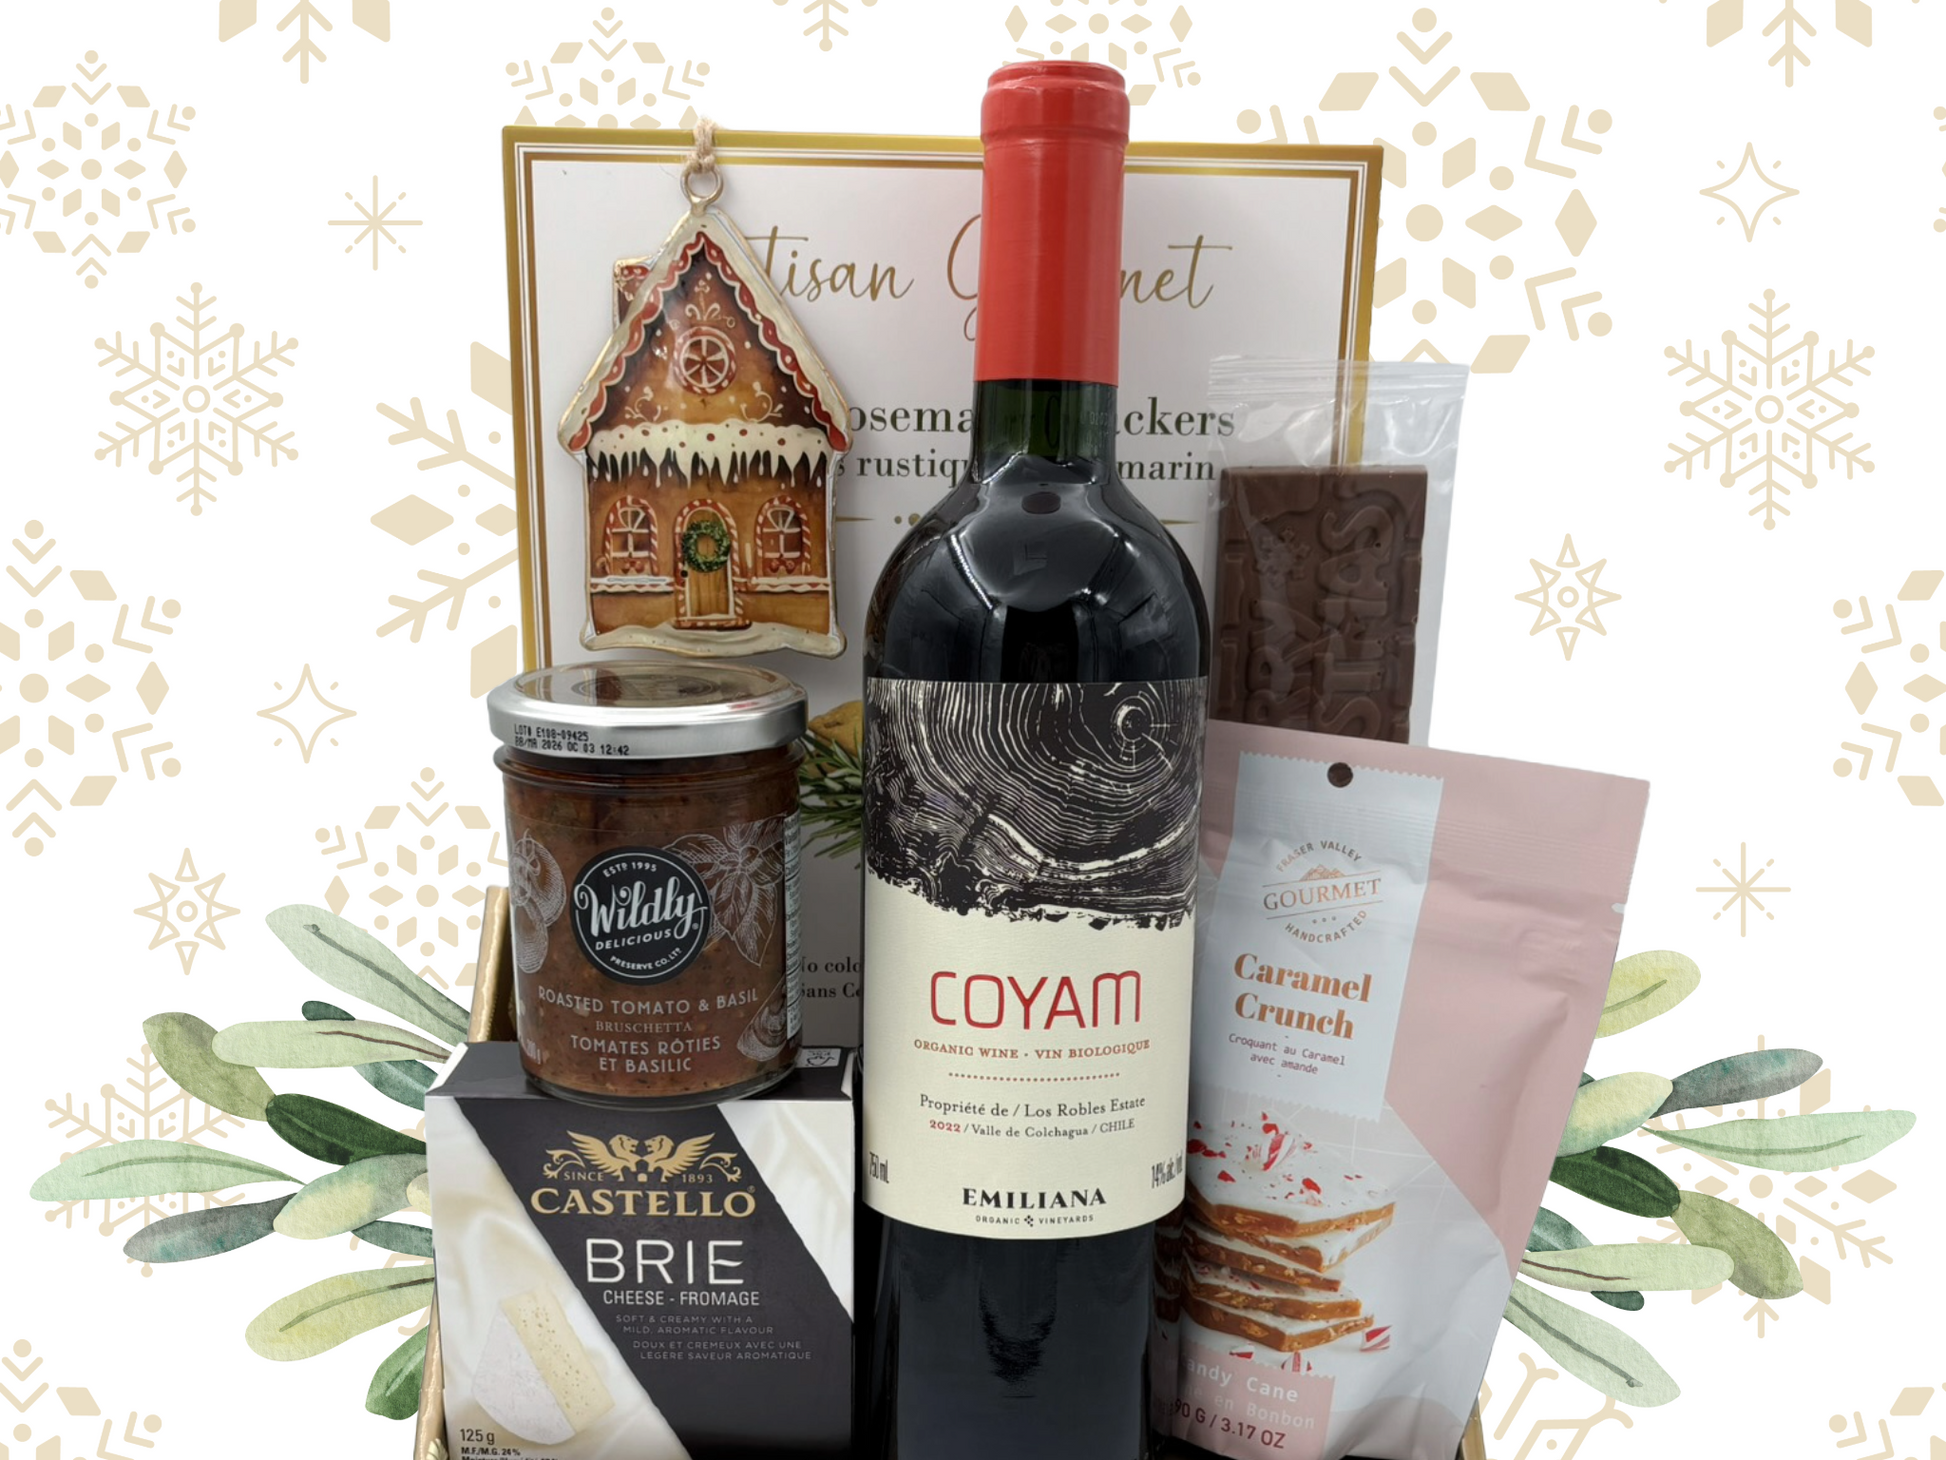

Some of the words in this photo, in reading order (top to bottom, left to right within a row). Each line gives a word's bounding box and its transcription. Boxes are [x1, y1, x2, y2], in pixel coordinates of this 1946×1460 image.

[744, 225, 915, 302] tisan
[849, 406, 974, 433] osema
[1124, 396, 1235, 437] ckers
[856, 448, 969, 489] rustiq
[1117, 451, 1216, 481] marin
[541, 739, 563, 751] 2026
[582, 743, 596, 754] 03
[600, 743, 630, 756] 12:42
[631, 861, 658, 872] 1995
[1276, 842, 1314, 872] FRASER
[1319, 840, 1362, 863] VALLEY
[1263, 878, 1382, 911] GOURMET
[573, 876, 708, 940] Wildly
[1284, 910, 1367, 944] HANDCRAFTED
[594, 928, 673, 951] DELICIOUS
[609, 955, 653, 970] PRESERVE
[1234, 952, 1373, 1003] Caramel
[538, 985, 604, 1013] ROASTED
[611, 999, 690, 1015] TOMATO
[698, 999, 709, 1012] &
[716, 987, 759, 1010] BASIL
[930, 970, 1142, 1030] COYAM
[595, 1019, 693, 1034] BRUSCHETTA
[1234, 992, 1355, 1041] Crunch
[570, 1034, 650, 1056] TOMATES
[657, 1035, 721, 1055] RÔTIES
[913, 1038, 974, 1057] ORGANIC
[978, 1047, 1019, 1059] WINE
[1034, 1049, 1063, 1060] VIN
[1067, 1039, 1151, 1059] BIOLOGIQUE
[1228, 1032, 1278, 1052] Croquant
[1283, 1045, 1297, 1056] au
[1301, 1048, 1346, 1066] Caramel
[599, 1057, 617, 1071] ET
[625, 1056, 692, 1074] BASILIC
[1249, 1053, 1276, 1066] avec
[1280, 1058, 1319, 1075] amande
[919, 1093, 986, 1116] Propriété
[990, 1102, 1009, 1117] de
[1024, 1104, 1053, 1118] Los
[1056, 1102, 1107, 1118] Robles
[1109, 1096, 1147, 1113] Estate
[929, 1119, 961, 1133] 2022
[971, 1123, 1002, 1137] Valle
[1005, 1125, 1021, 1138] de
[1024, 1126, 1090, 1140] Colchagua
[1099, 1117, 1136, 1134] CHILE
[563, 1170, 605, 1182] SINCE
[681, 1173, 713, 1184] 1893
[530, 1187, 757, 1218] CASTELLO
[962, 1187, 1107, 1209] EMILIANA
[975, 1214, 1021, 1225] ORGANIC
[1038, 1213, 1094, 1225] VINEYARDS
[585, 1238, 745, 1285] BRIE
[602, 1289, 664, 1306] CHEESE
[679, 1291, 760, 1306] FROMAGE
[615, 1314, 645, 1323] SOFT
[648, 1315, 657, 1323] &
[659, 1315, 707, 1324] CREAMY
[711, 1315, 742, 1324] WITH
[745, 1315, 754, 1324] A
[657, 1326, 716, 1335] AROMATIC
[720, 1326, 774, 1335] FLAVOUR
[633, 1340, 666, 1349] DOUX
[669, 1341, 683, 1349] ET
[745, 1341, 776, 1350] AVEC
[779, 1341, 802, 1350] UNE
[687, 1351, 733, 1361] SAVEUR
[736, 1351, 812, 1361] AROMATIQUE
[1246, 1376, 1299, 1402] Cane
[1247, 1403, 1315, 1430] Bonbon
[460, 1428, 484, 1442] 125
[486, 1431, 495, 1446] g
[1195, 1407, 1206, 1424] G
[1220, 1416, 1257, 1440] 3.17
[1260, 1429, 1287, 1450] OZ
